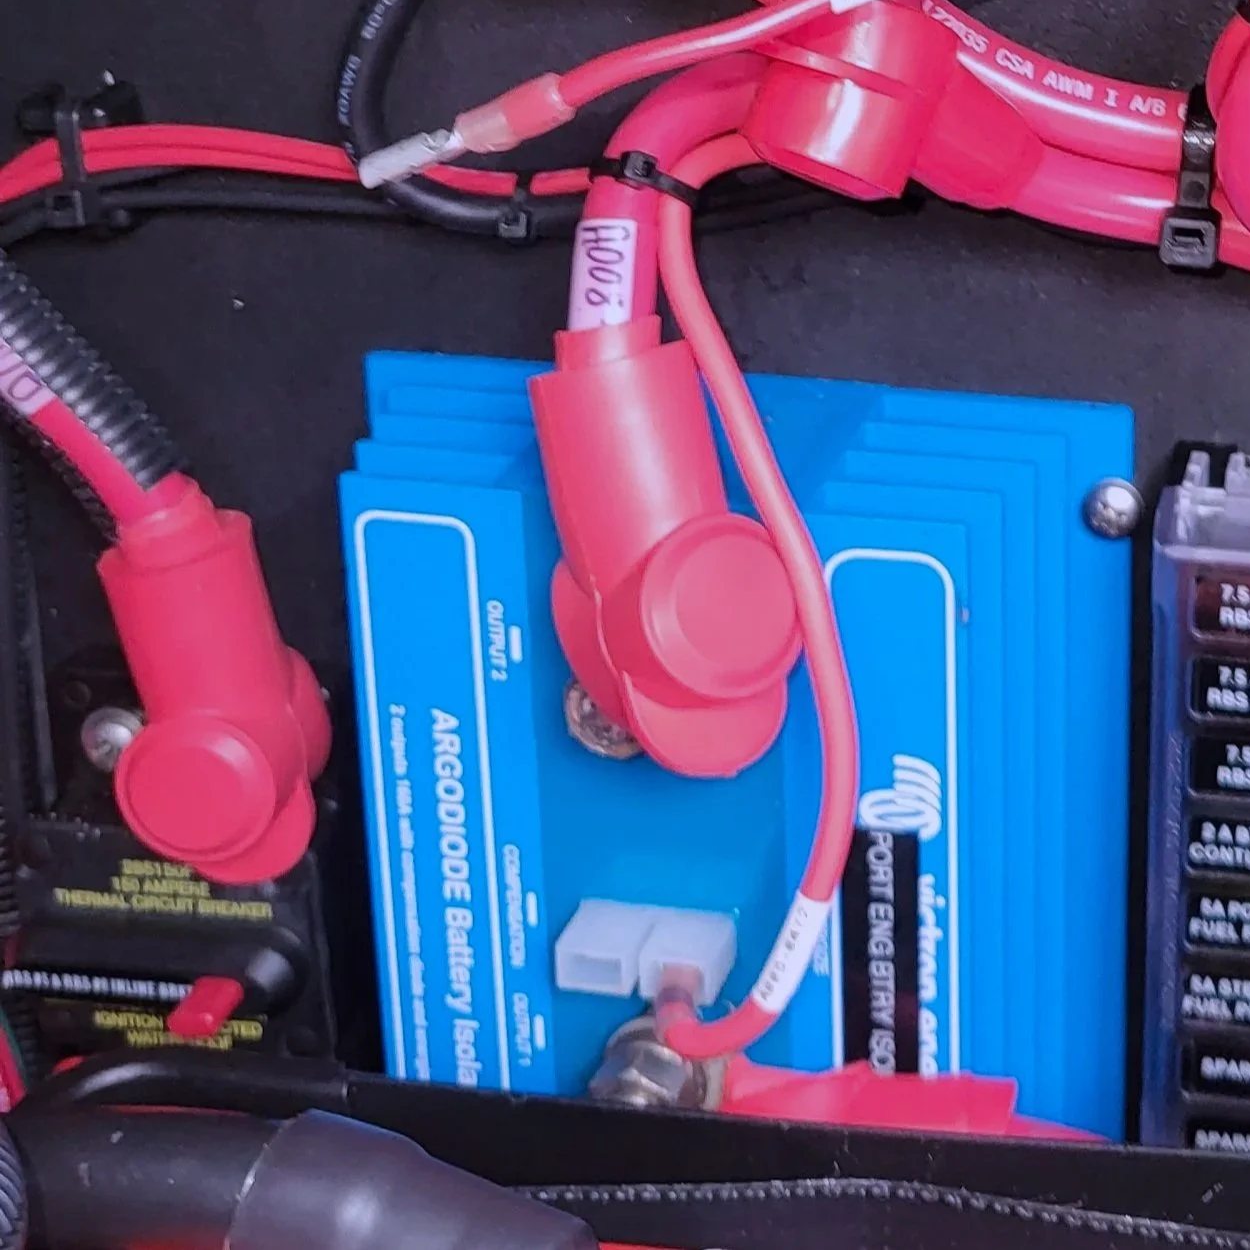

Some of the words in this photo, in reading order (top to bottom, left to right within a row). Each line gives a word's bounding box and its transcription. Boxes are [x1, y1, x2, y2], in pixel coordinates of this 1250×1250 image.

[995, 47, 1034, 80] CSA
[485, 600, 507, 666] OUTPUT
[491, 668, 508, 682] 2
[1207, 687, 1249, 713] RBS
[430, 707, 472, 902] ARGODIODE
[866, 832, 894, 901] PORT
[868, 903, 895, 959] ENG
[1189, 917, 1240, 944] FUEL
[444, 907, 474, 1015] Battery
[95, 1010, 164, 1032] IGNITION
[869, 960, 896, 1029] BTRY
[453, 1018, 482, 1088] Isola
[869, 1030, 896, 1076] ISO
